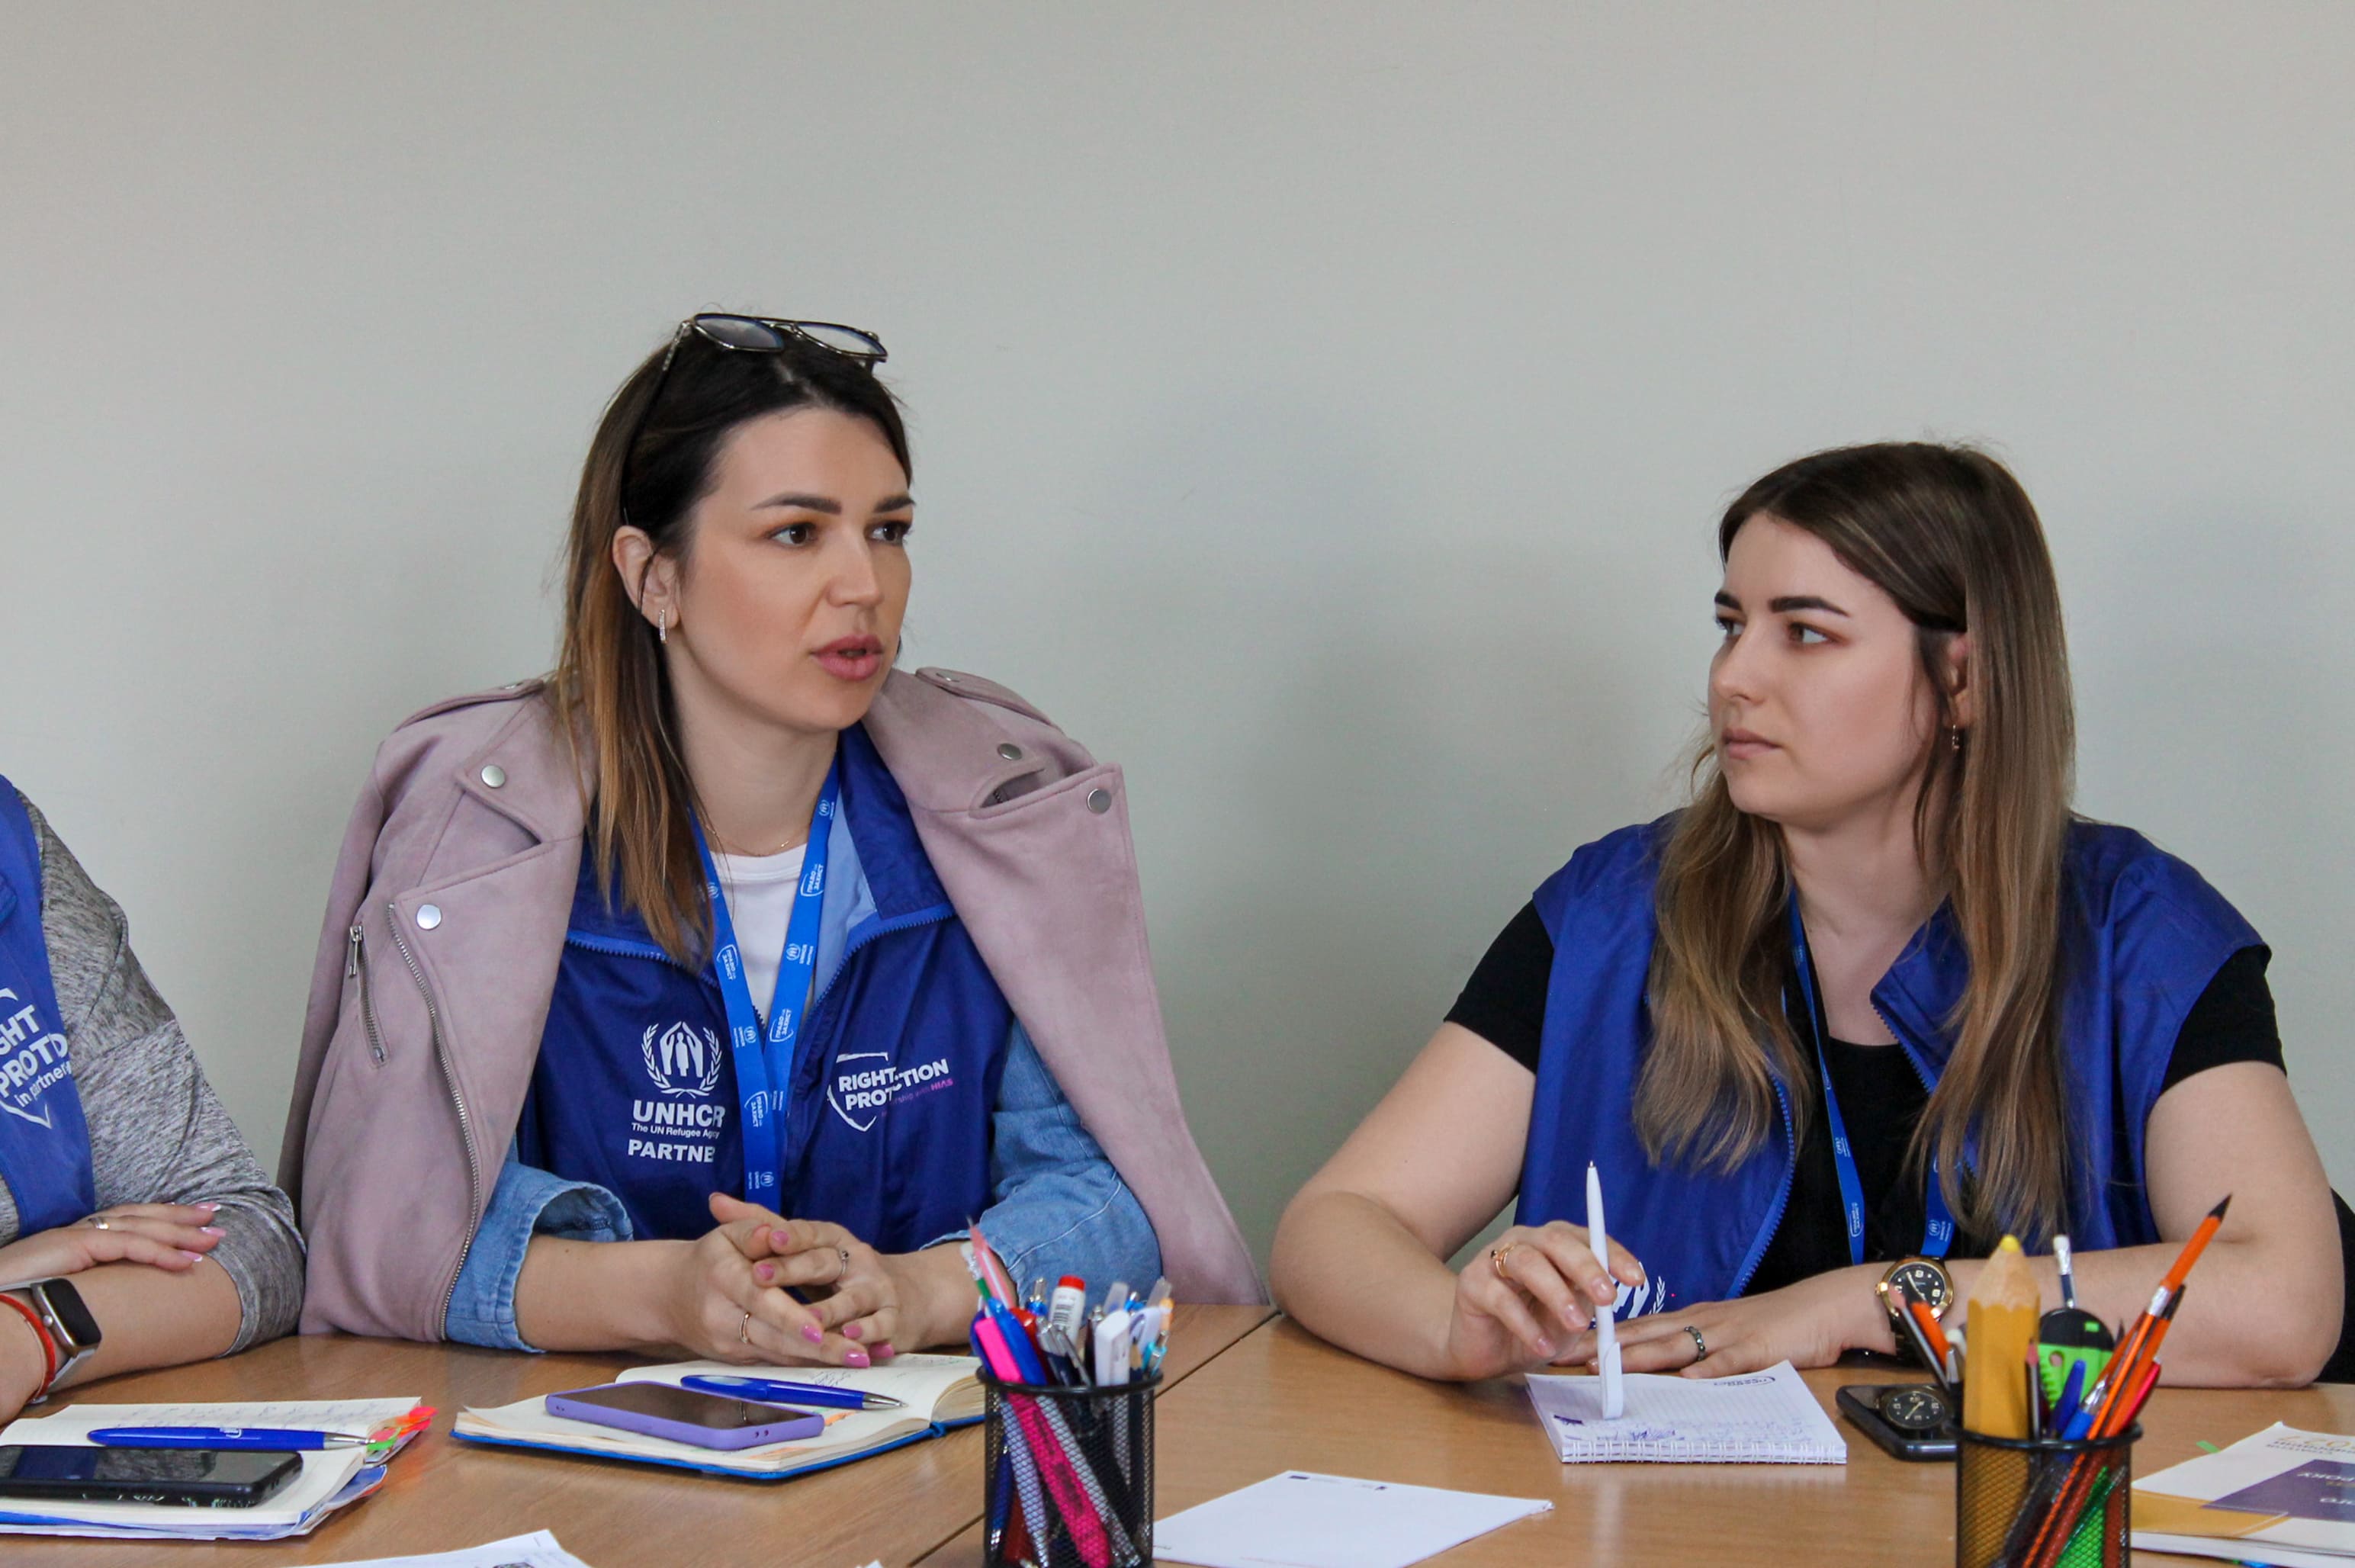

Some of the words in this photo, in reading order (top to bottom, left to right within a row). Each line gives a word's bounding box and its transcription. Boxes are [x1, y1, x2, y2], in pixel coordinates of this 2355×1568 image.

[839, 1067, 896, 1092] RIGHT
[633, 1100, 725, 1128] UNHCR
[631, 1122, 648, 1133] The
[650, 1125, 665, 1135] UN
[666, 1126, 701, 1139] Refugee
[628, 1139, 715, 1163] PARTNE
